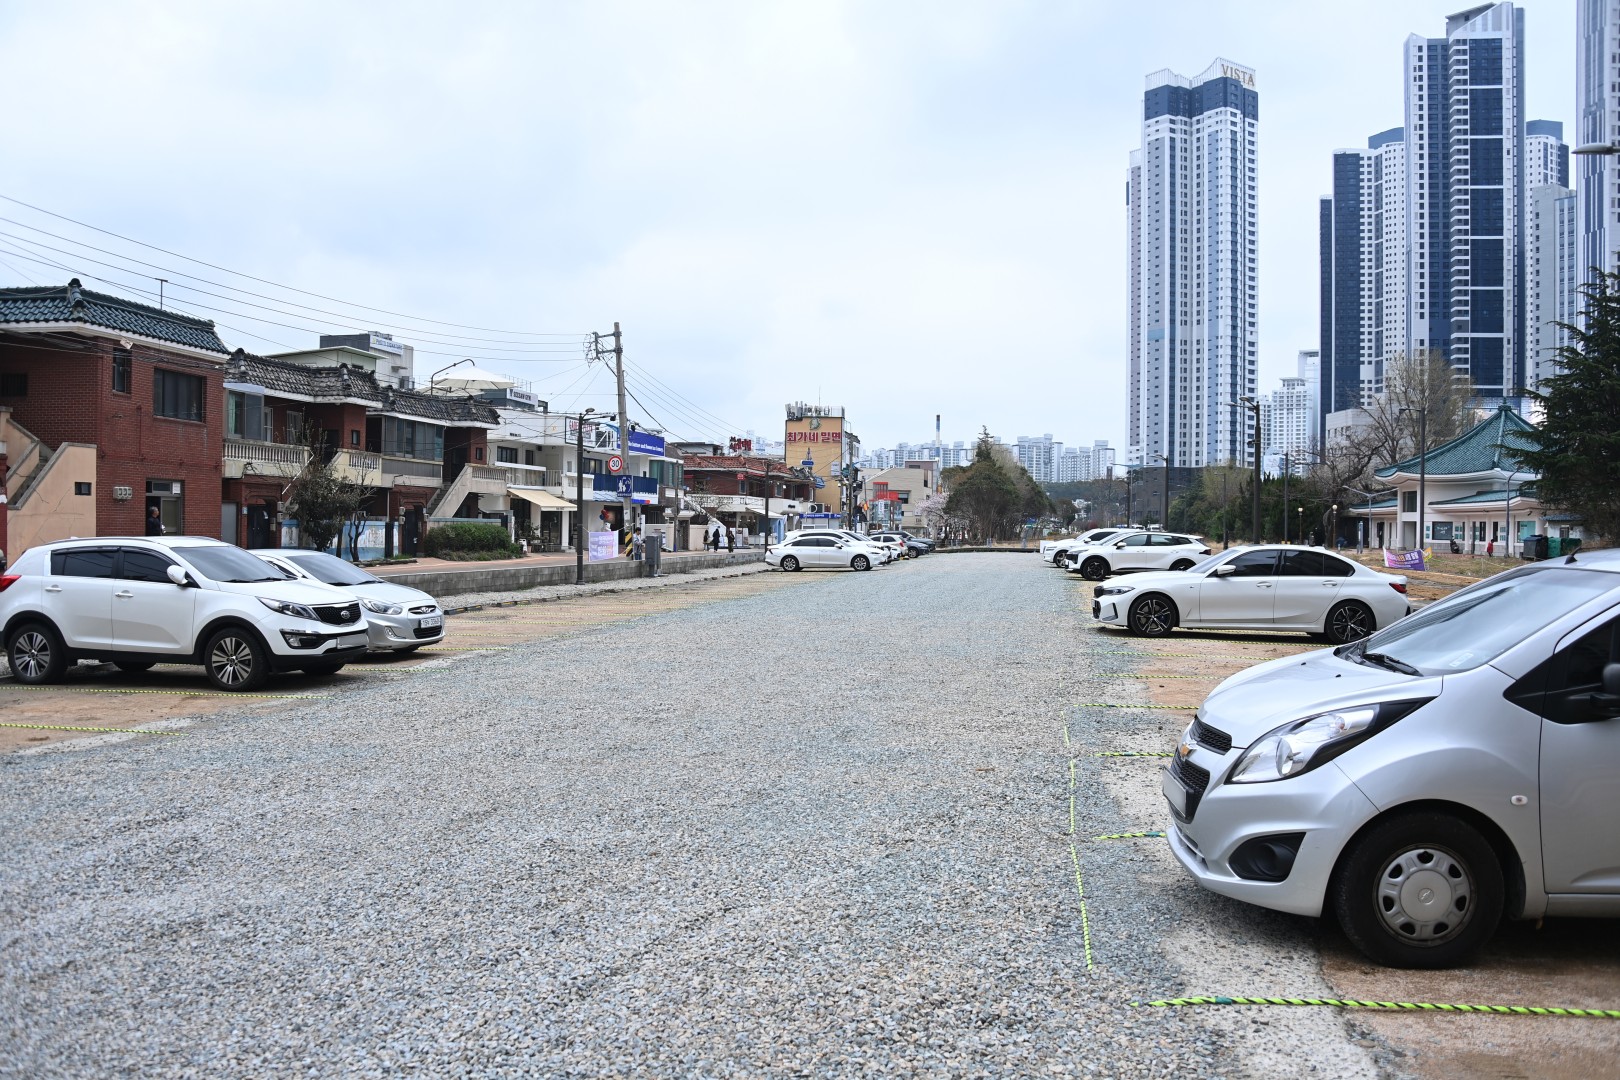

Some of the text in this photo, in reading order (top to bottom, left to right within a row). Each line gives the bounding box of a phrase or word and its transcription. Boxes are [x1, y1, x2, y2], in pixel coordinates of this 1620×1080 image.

[1221, 63, 1255, 87] VISTA
[787, 431, 841, 443] 최가네 밀면
[611, 459, 620, 468] 30
